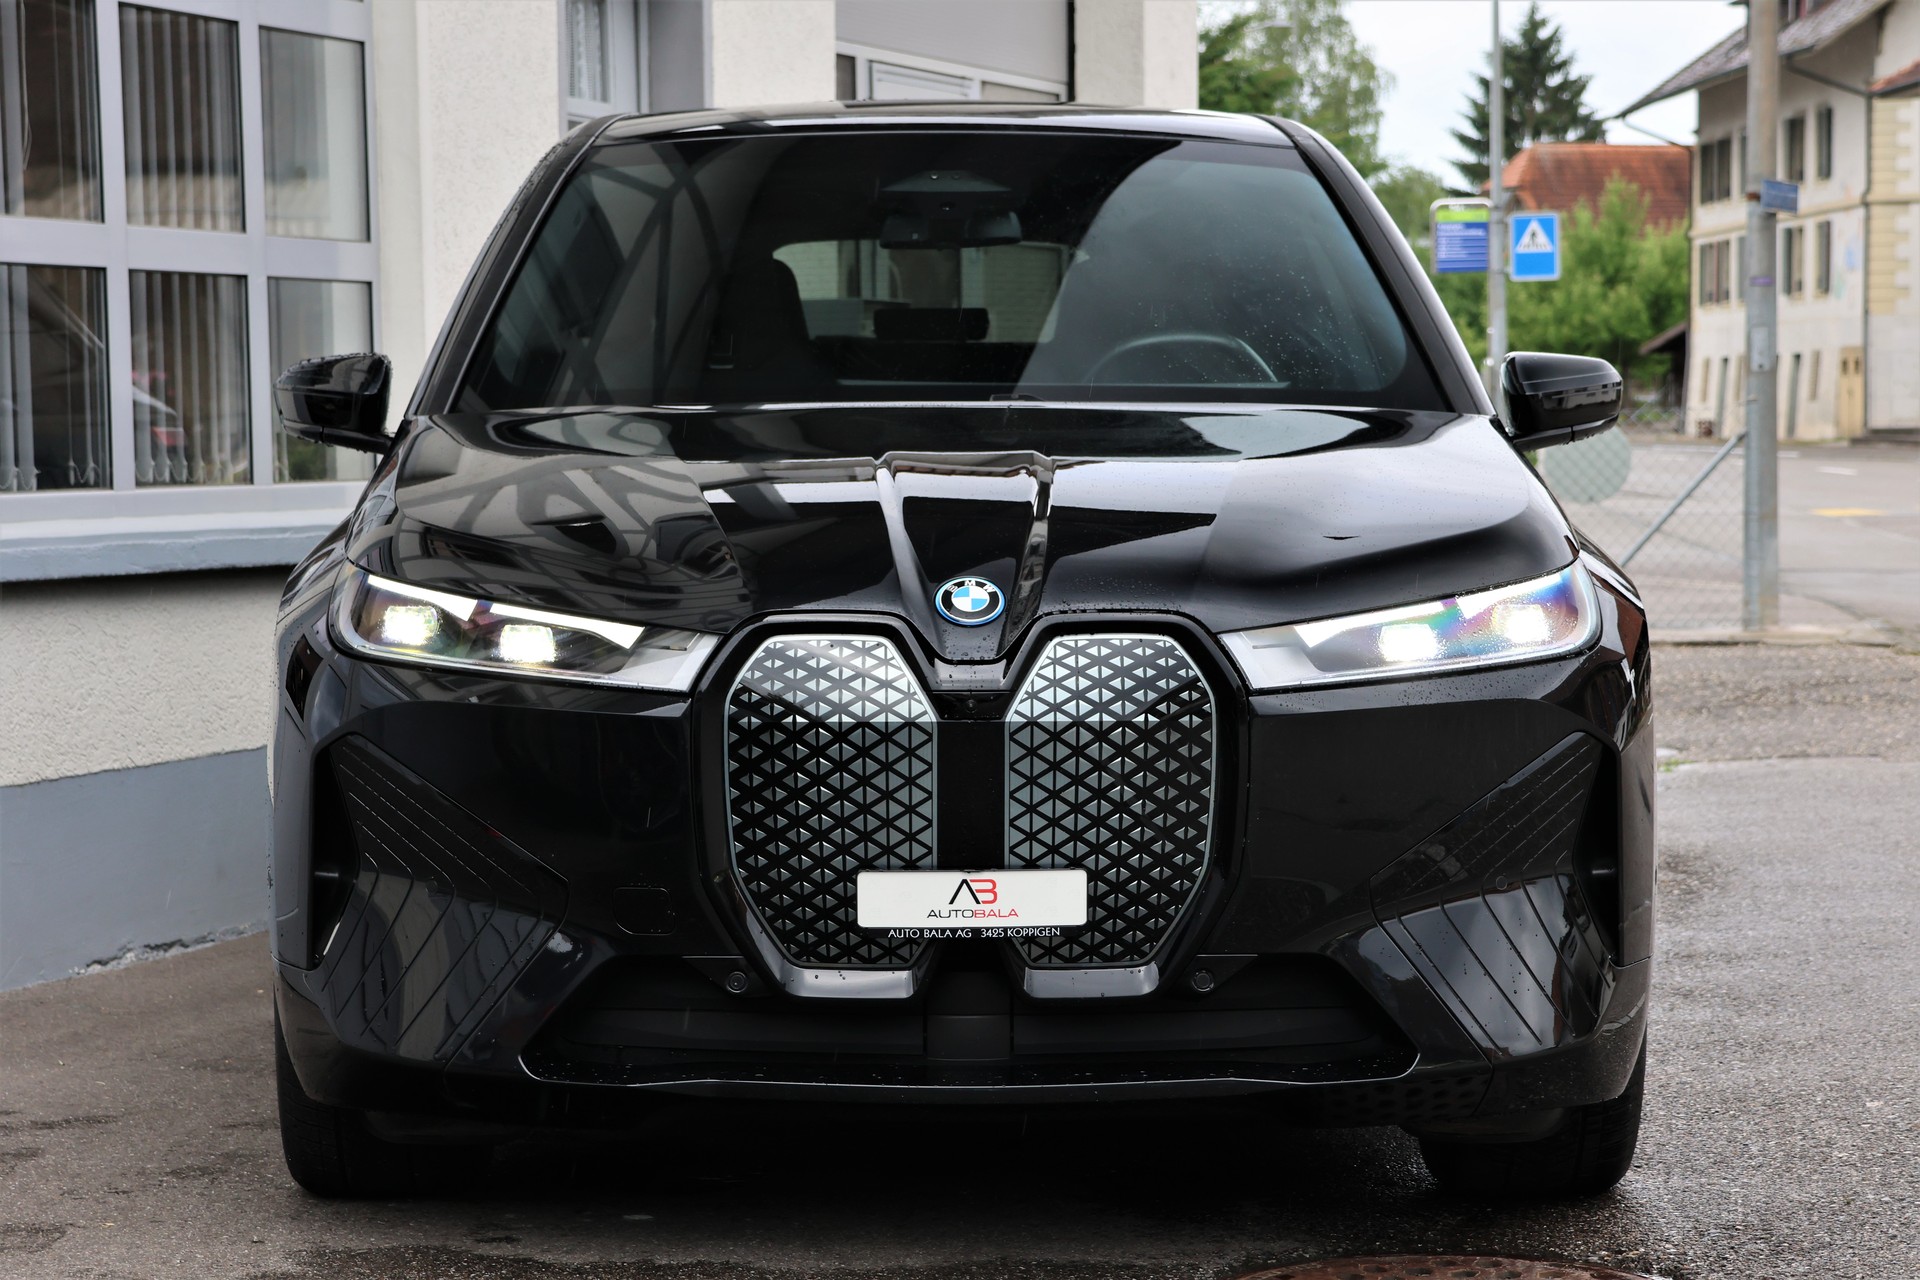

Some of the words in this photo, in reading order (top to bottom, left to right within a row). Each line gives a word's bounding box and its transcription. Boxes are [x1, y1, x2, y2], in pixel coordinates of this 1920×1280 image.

[946, 580, 996, 593] BMW
[927, 908, 1019, 919] AUTOBALA
[888, 928, 920, 939] AUTO
[924, 928, 953, 939] BALA
[955, 928, 972, 938] AG
[980, 928, 1005, 938] 3425
[1007, 927, 1061, 938] KOPPIGEN
